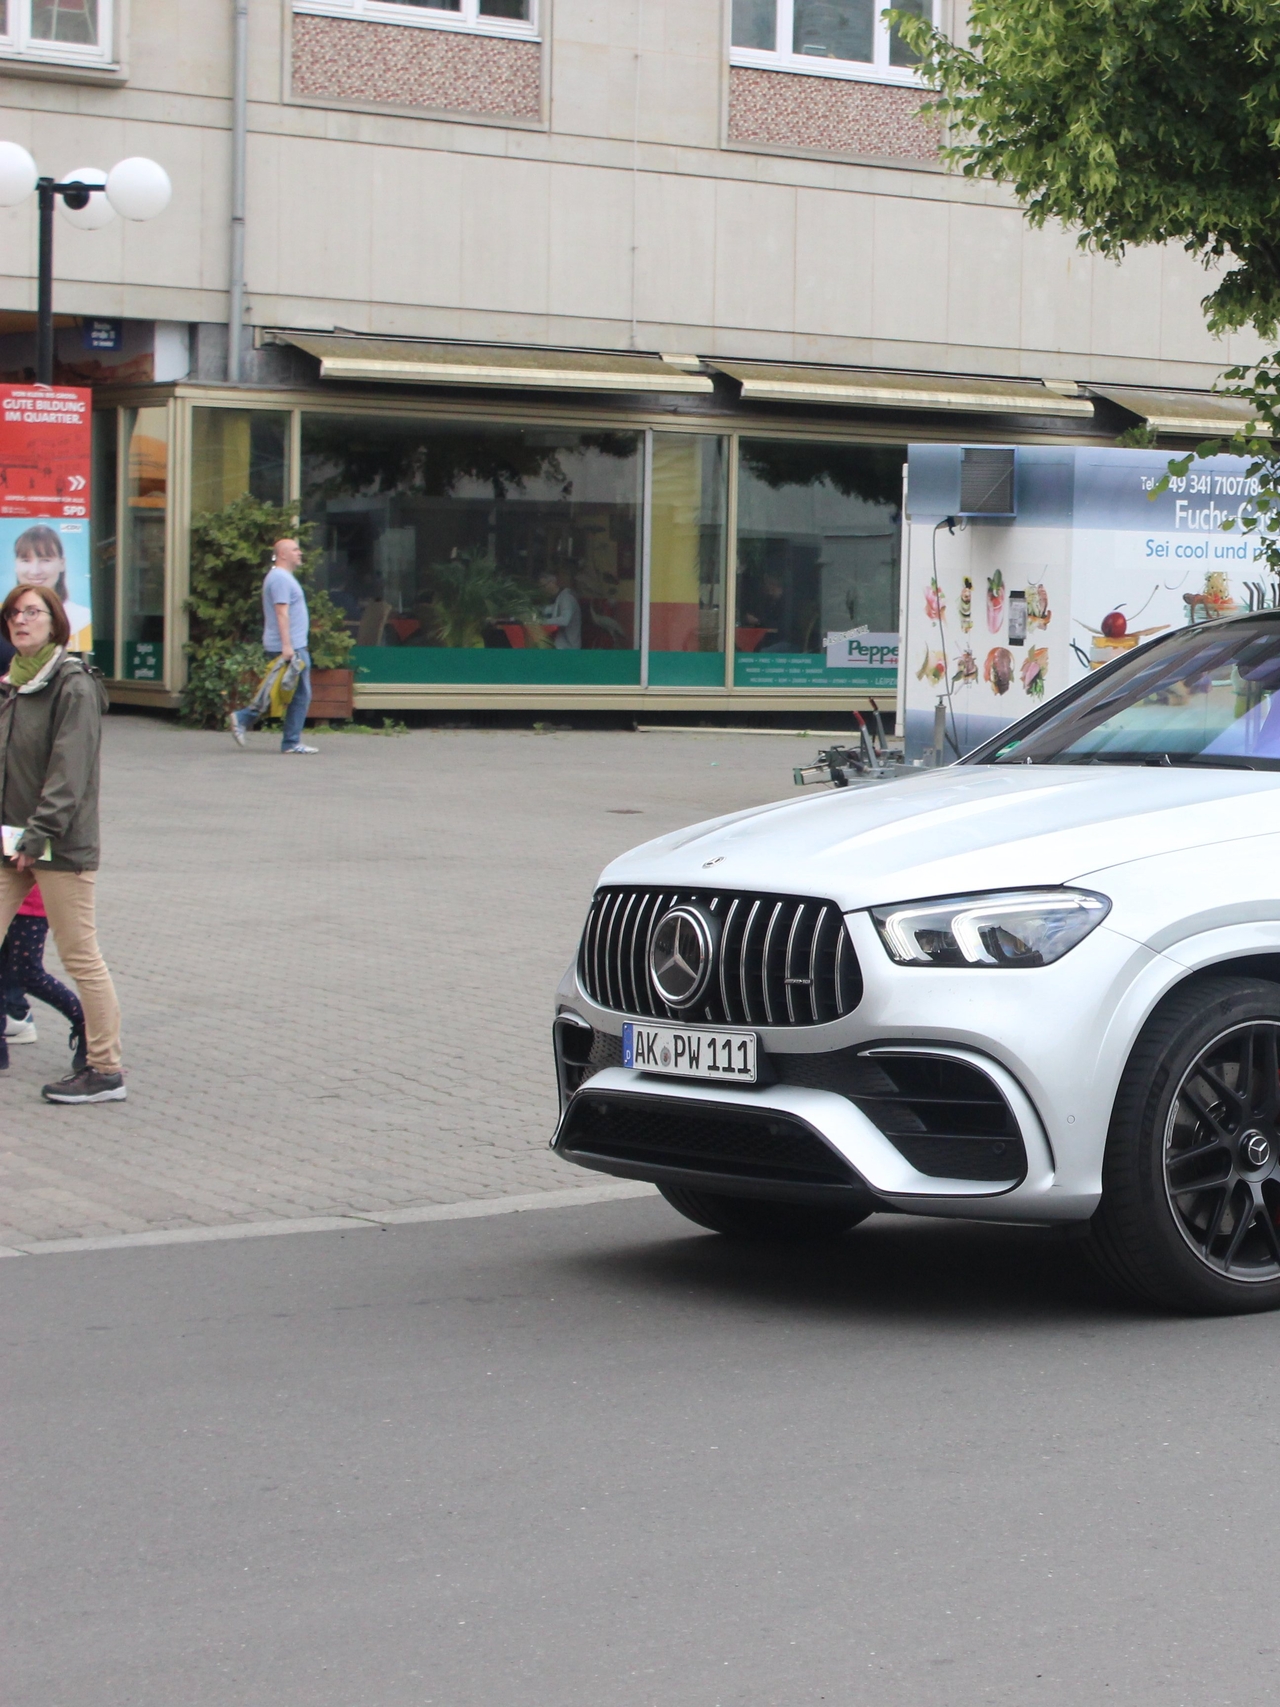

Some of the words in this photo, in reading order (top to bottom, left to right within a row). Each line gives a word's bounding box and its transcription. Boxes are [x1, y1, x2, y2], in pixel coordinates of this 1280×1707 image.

[2, 399, 34, 410] GUTE
[36, 400, 86, 412] BILDUNG
[5, 411, 21, 421] IM
[24, 412, 83, 424] QUARTIER.
[1189, 475, 1211, 494] 341
[63, 505, 86, 516] SPD
[1146, 539, 1169, 557] Sei
[1175, 541, 1209, 558] cool
[1215, 542, 1247, 559] und
[635, 1030, 659, 1065] AK
[673, 1034, 701, 1069] PW
[707, 1037, 751, 1074] 111
